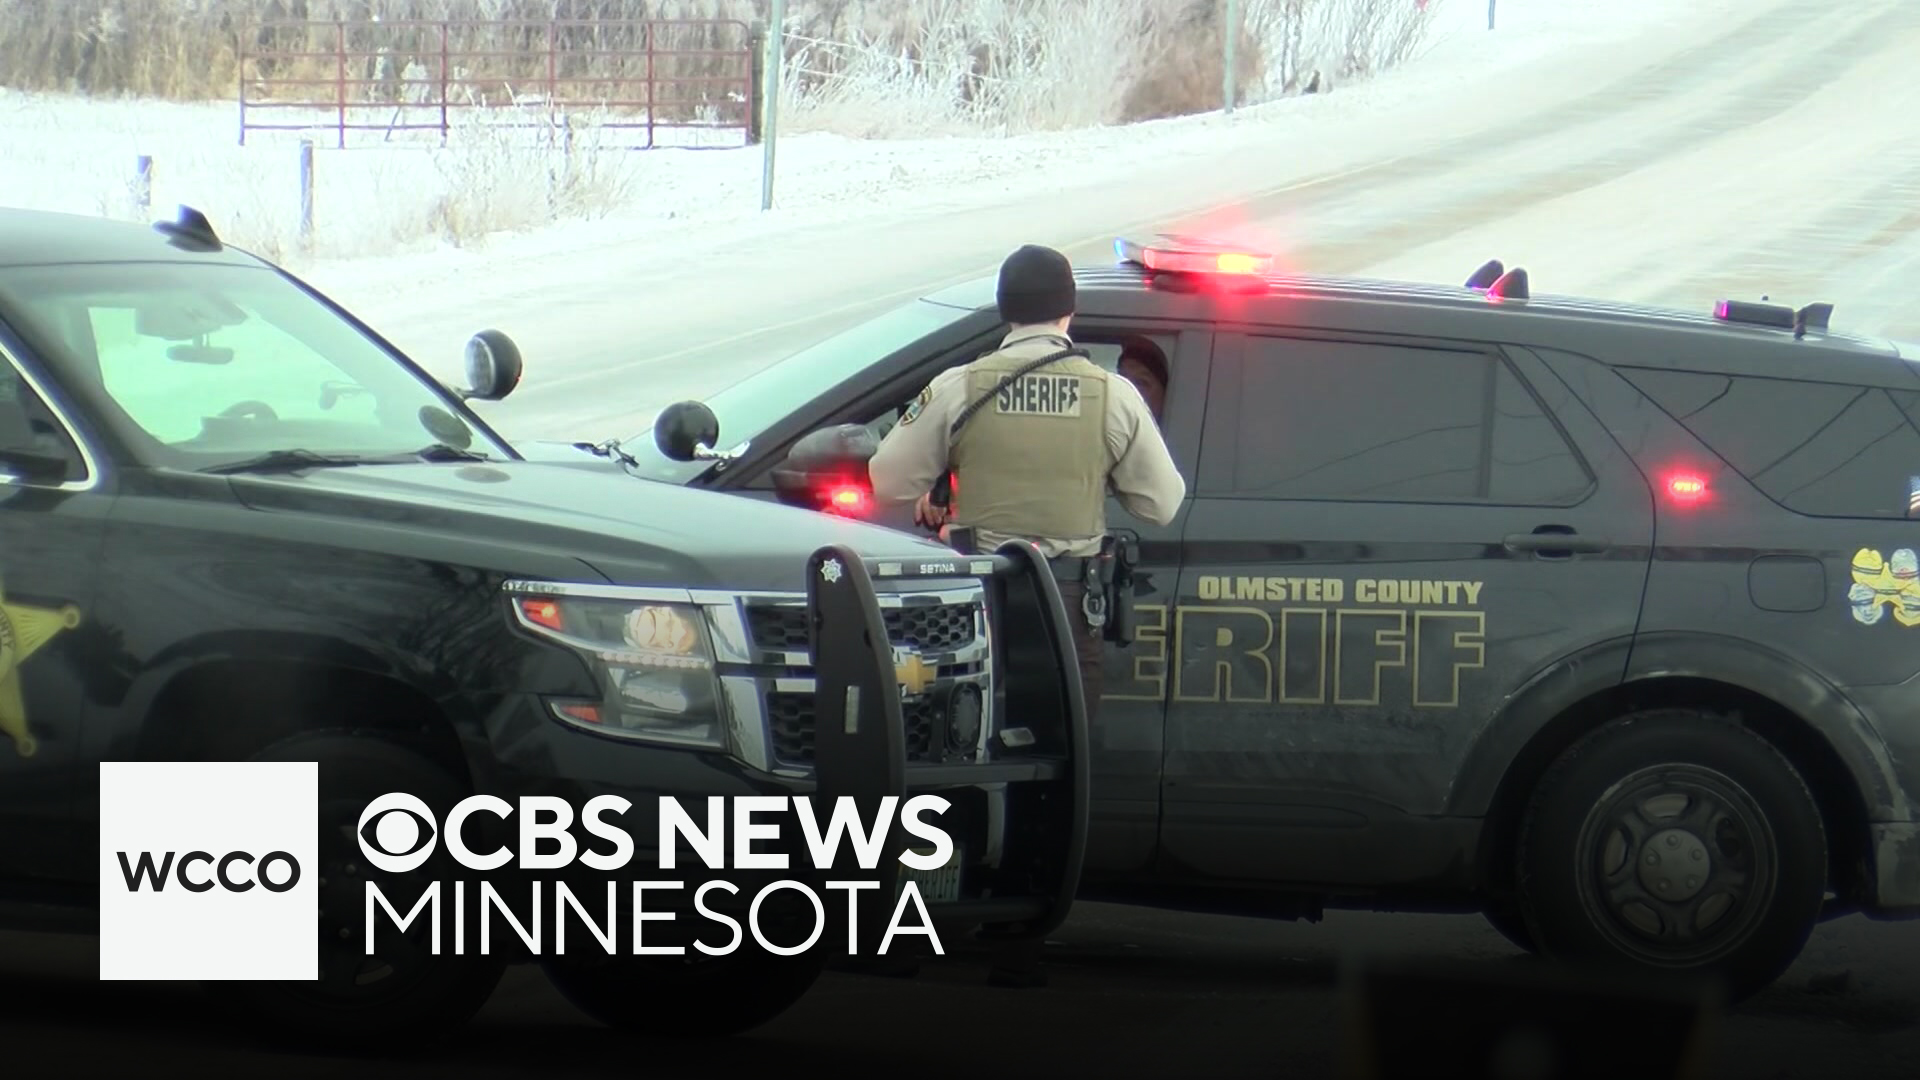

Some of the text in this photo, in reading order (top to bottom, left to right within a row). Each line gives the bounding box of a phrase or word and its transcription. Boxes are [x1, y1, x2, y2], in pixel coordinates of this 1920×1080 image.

[999, 375, 1079, 413] SHERIFF
[920, 563, 955, 574] SETINA
[1199, 576, 1484, 604] OLMSTED COUNTY
